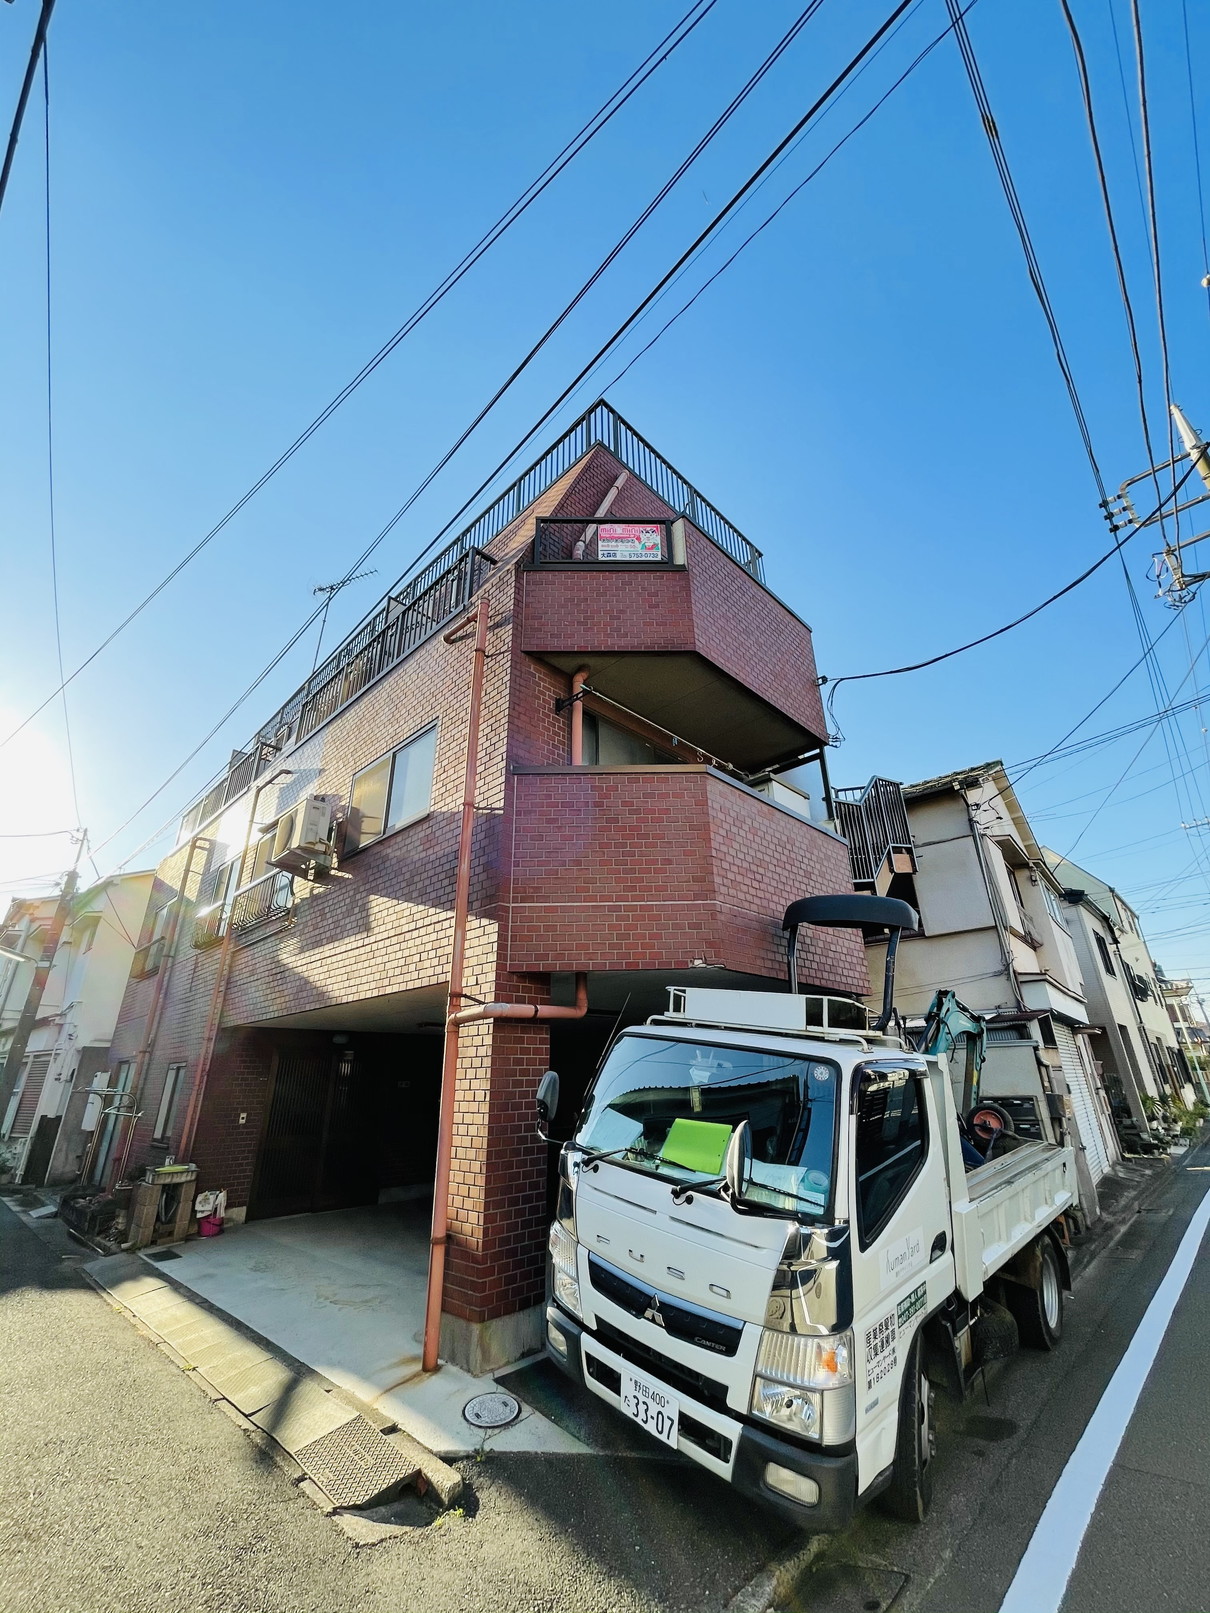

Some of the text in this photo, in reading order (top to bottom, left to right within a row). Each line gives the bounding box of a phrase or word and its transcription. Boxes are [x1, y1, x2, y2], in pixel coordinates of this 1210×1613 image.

[596, 1234, 732, 1300] FUSO
[694, 1336, 726, 1352] CANTER
[866, 1313, 896, 1348] 産業廃棄物
[866, 1327, 897, 1364] 収集運搬車
[632, 1394, 675, 1441] 33-07
